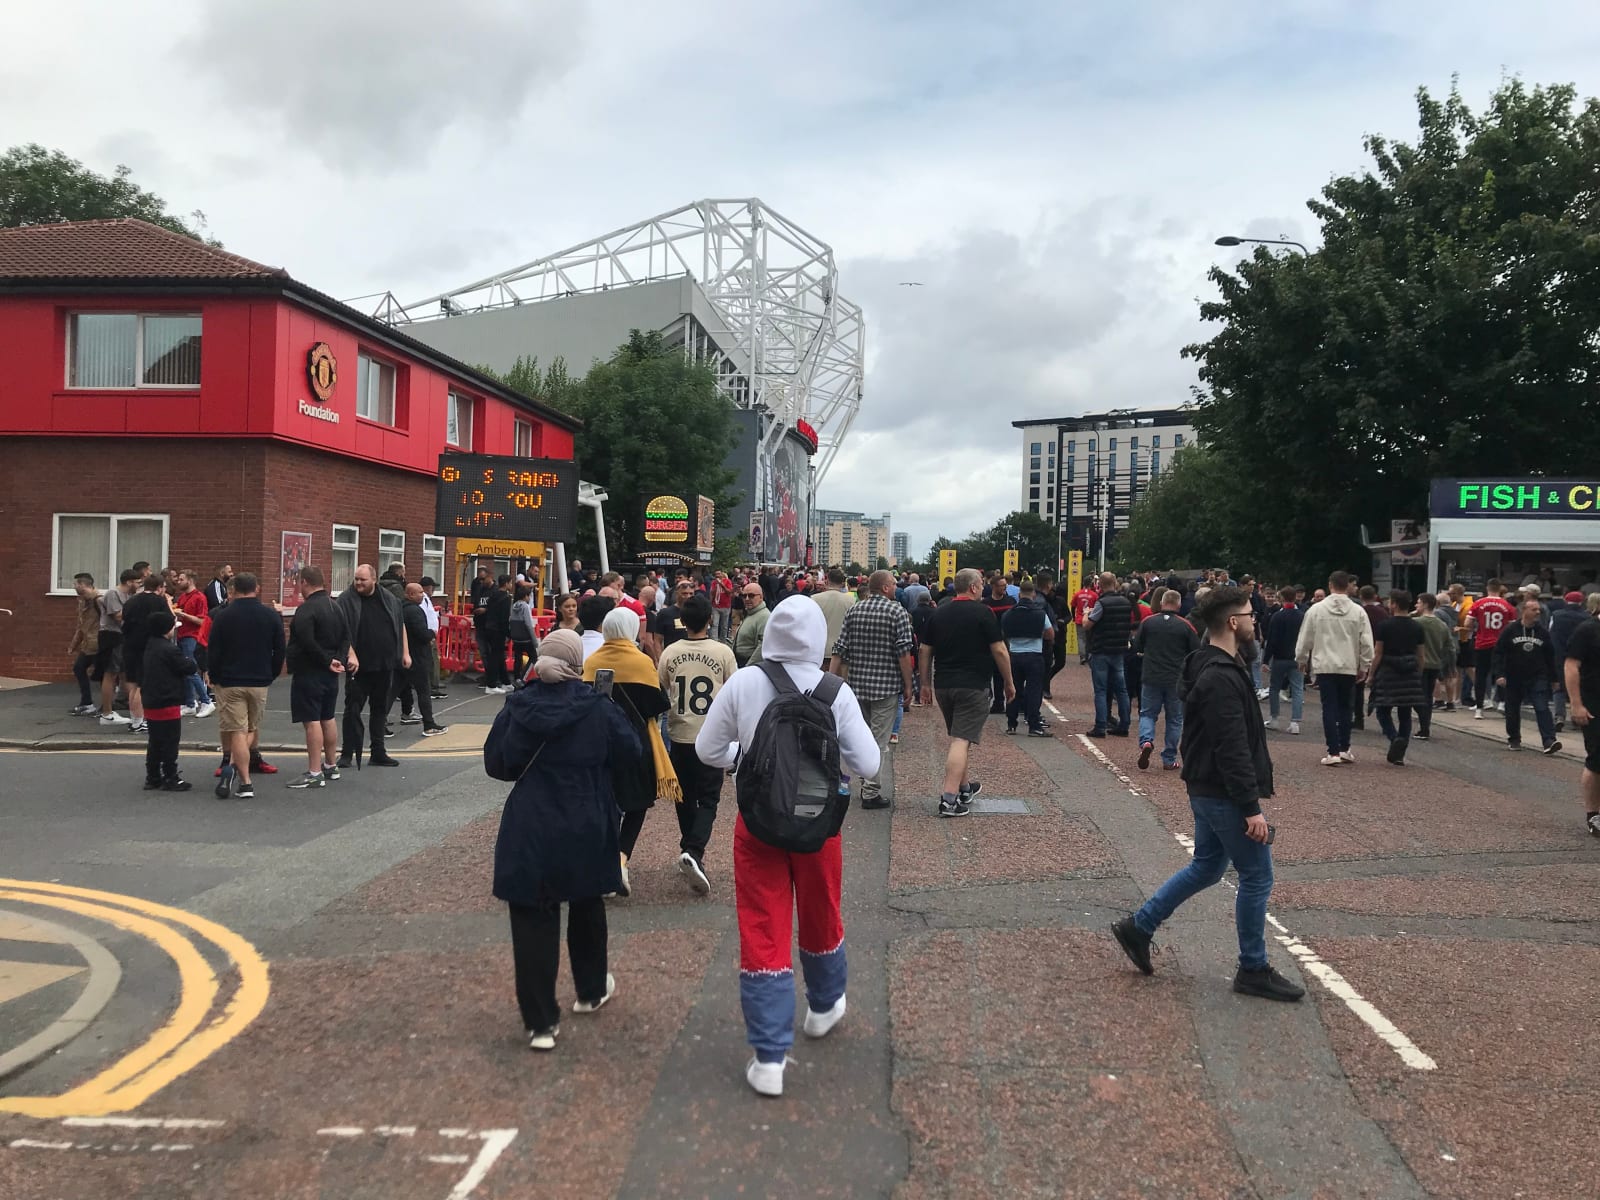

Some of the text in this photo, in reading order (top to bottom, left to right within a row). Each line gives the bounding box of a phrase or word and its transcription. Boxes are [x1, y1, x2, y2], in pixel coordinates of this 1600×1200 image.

[298, 399, 340, 424] Foundation
[1459, 484, 1541, 509] FISH
[1547, 491, 1560, 504] &
[646, 520, 688, 530] BURGER
[475, 544, 525, 556] Amberon
[1484, 611, 1504, 630] 18
[667, 652, 722, 675] B.FERNANDES
[675, 675, 714, 716] 18
